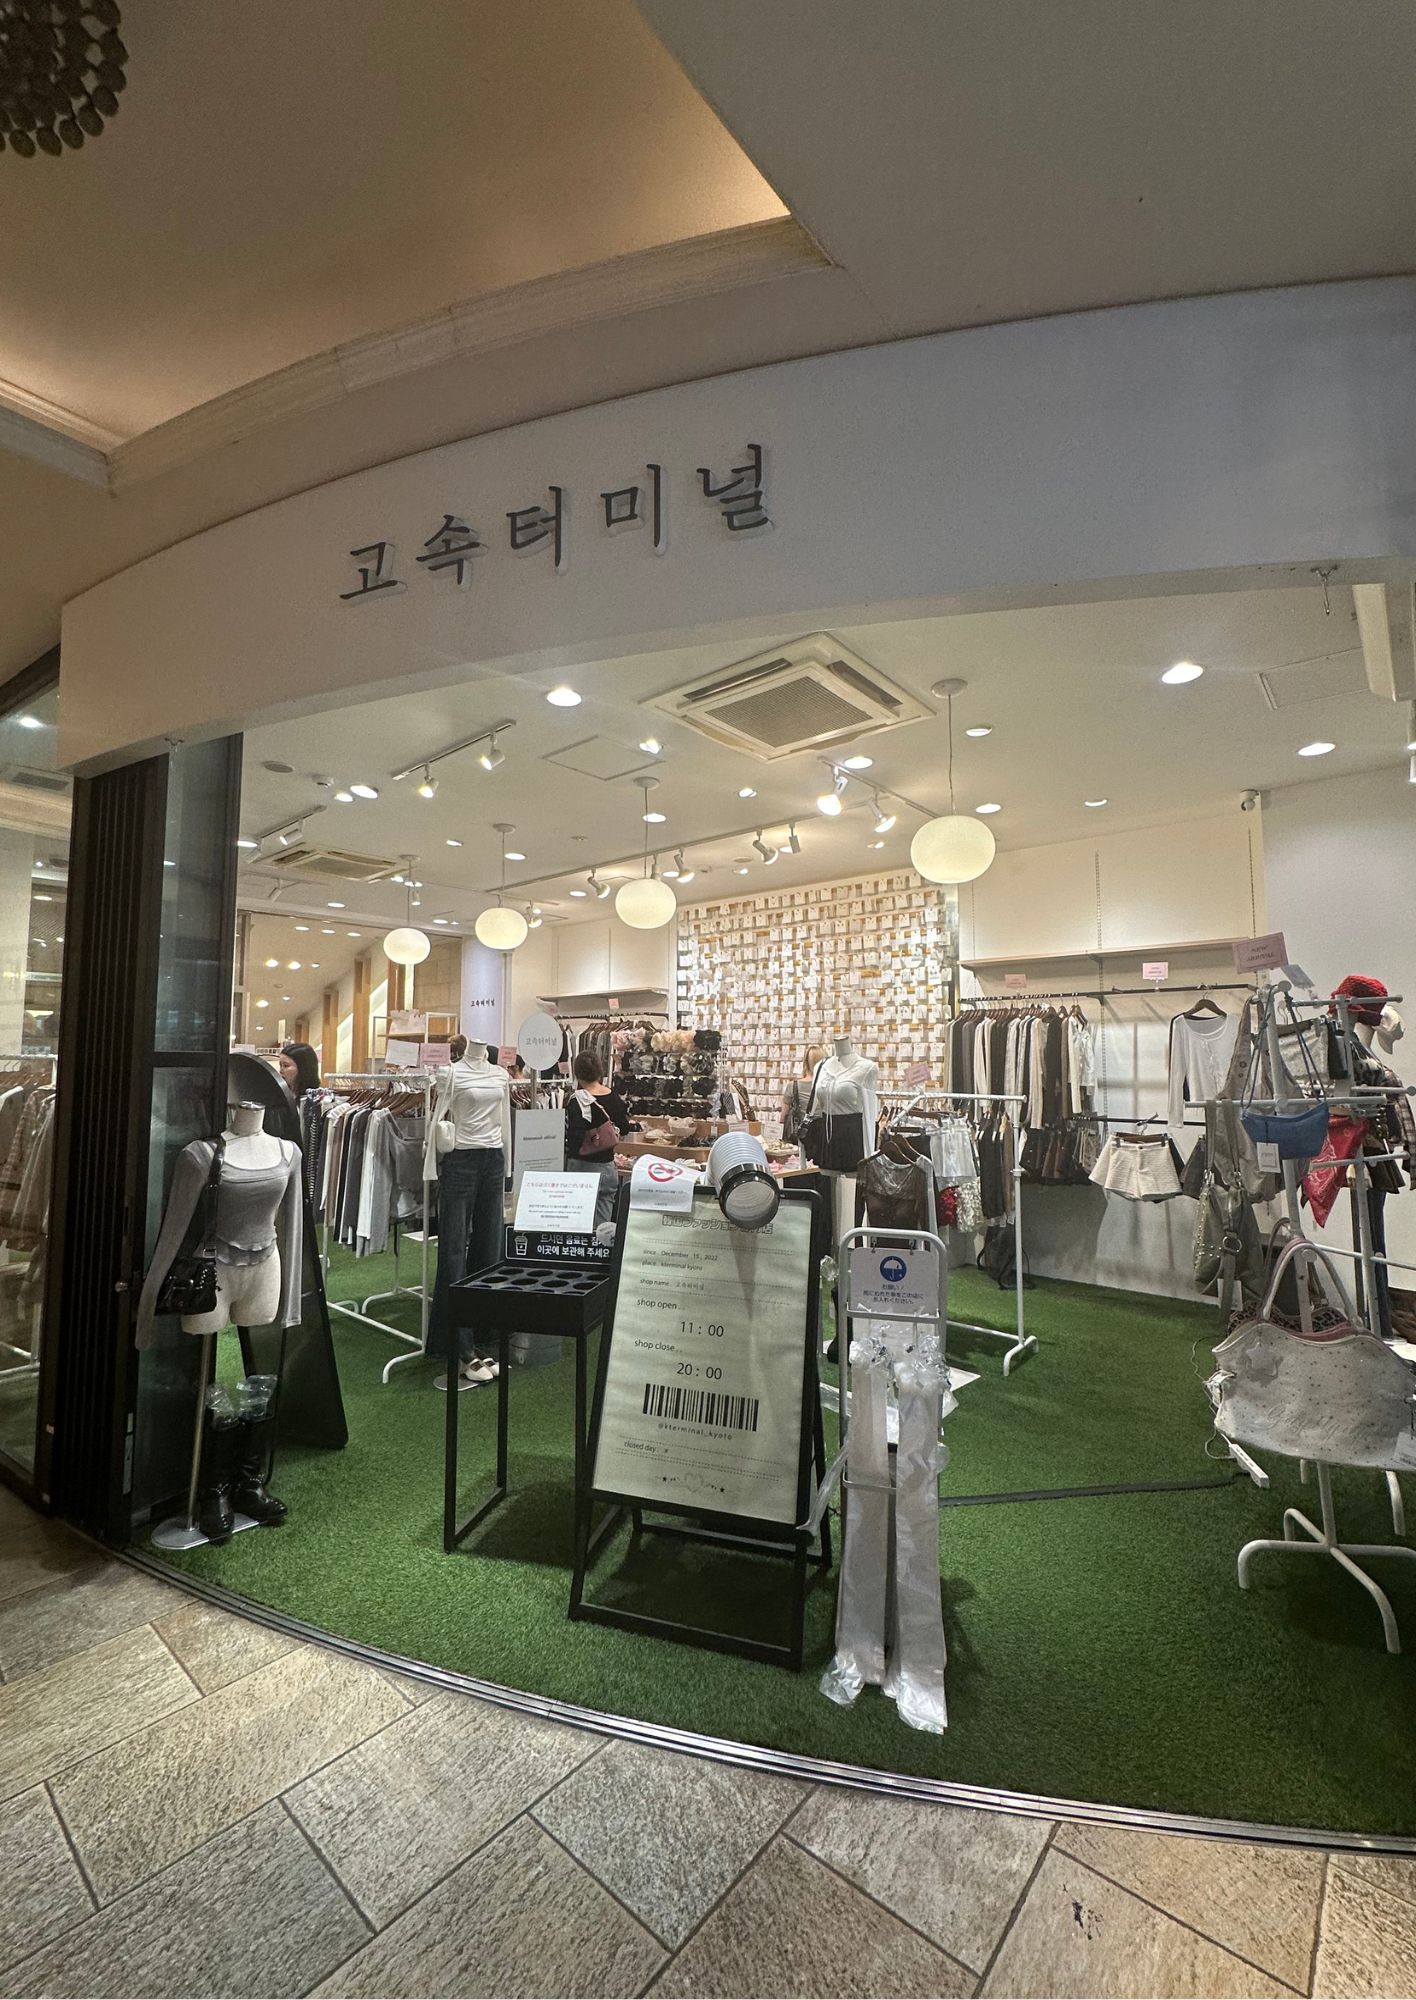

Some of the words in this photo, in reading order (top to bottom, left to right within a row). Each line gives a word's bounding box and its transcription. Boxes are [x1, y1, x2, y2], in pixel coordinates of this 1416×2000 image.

[339, 443, 770, 600] 고속터미널
[537, 1244, 560, 1256] 이곳에
[561, 1246, 585, 1257] 보관해
[587, 1247, 610, 1258] 주세요
[637, 1298, 656, 1309] shop
[634, 1339, 654, 1350] shop
